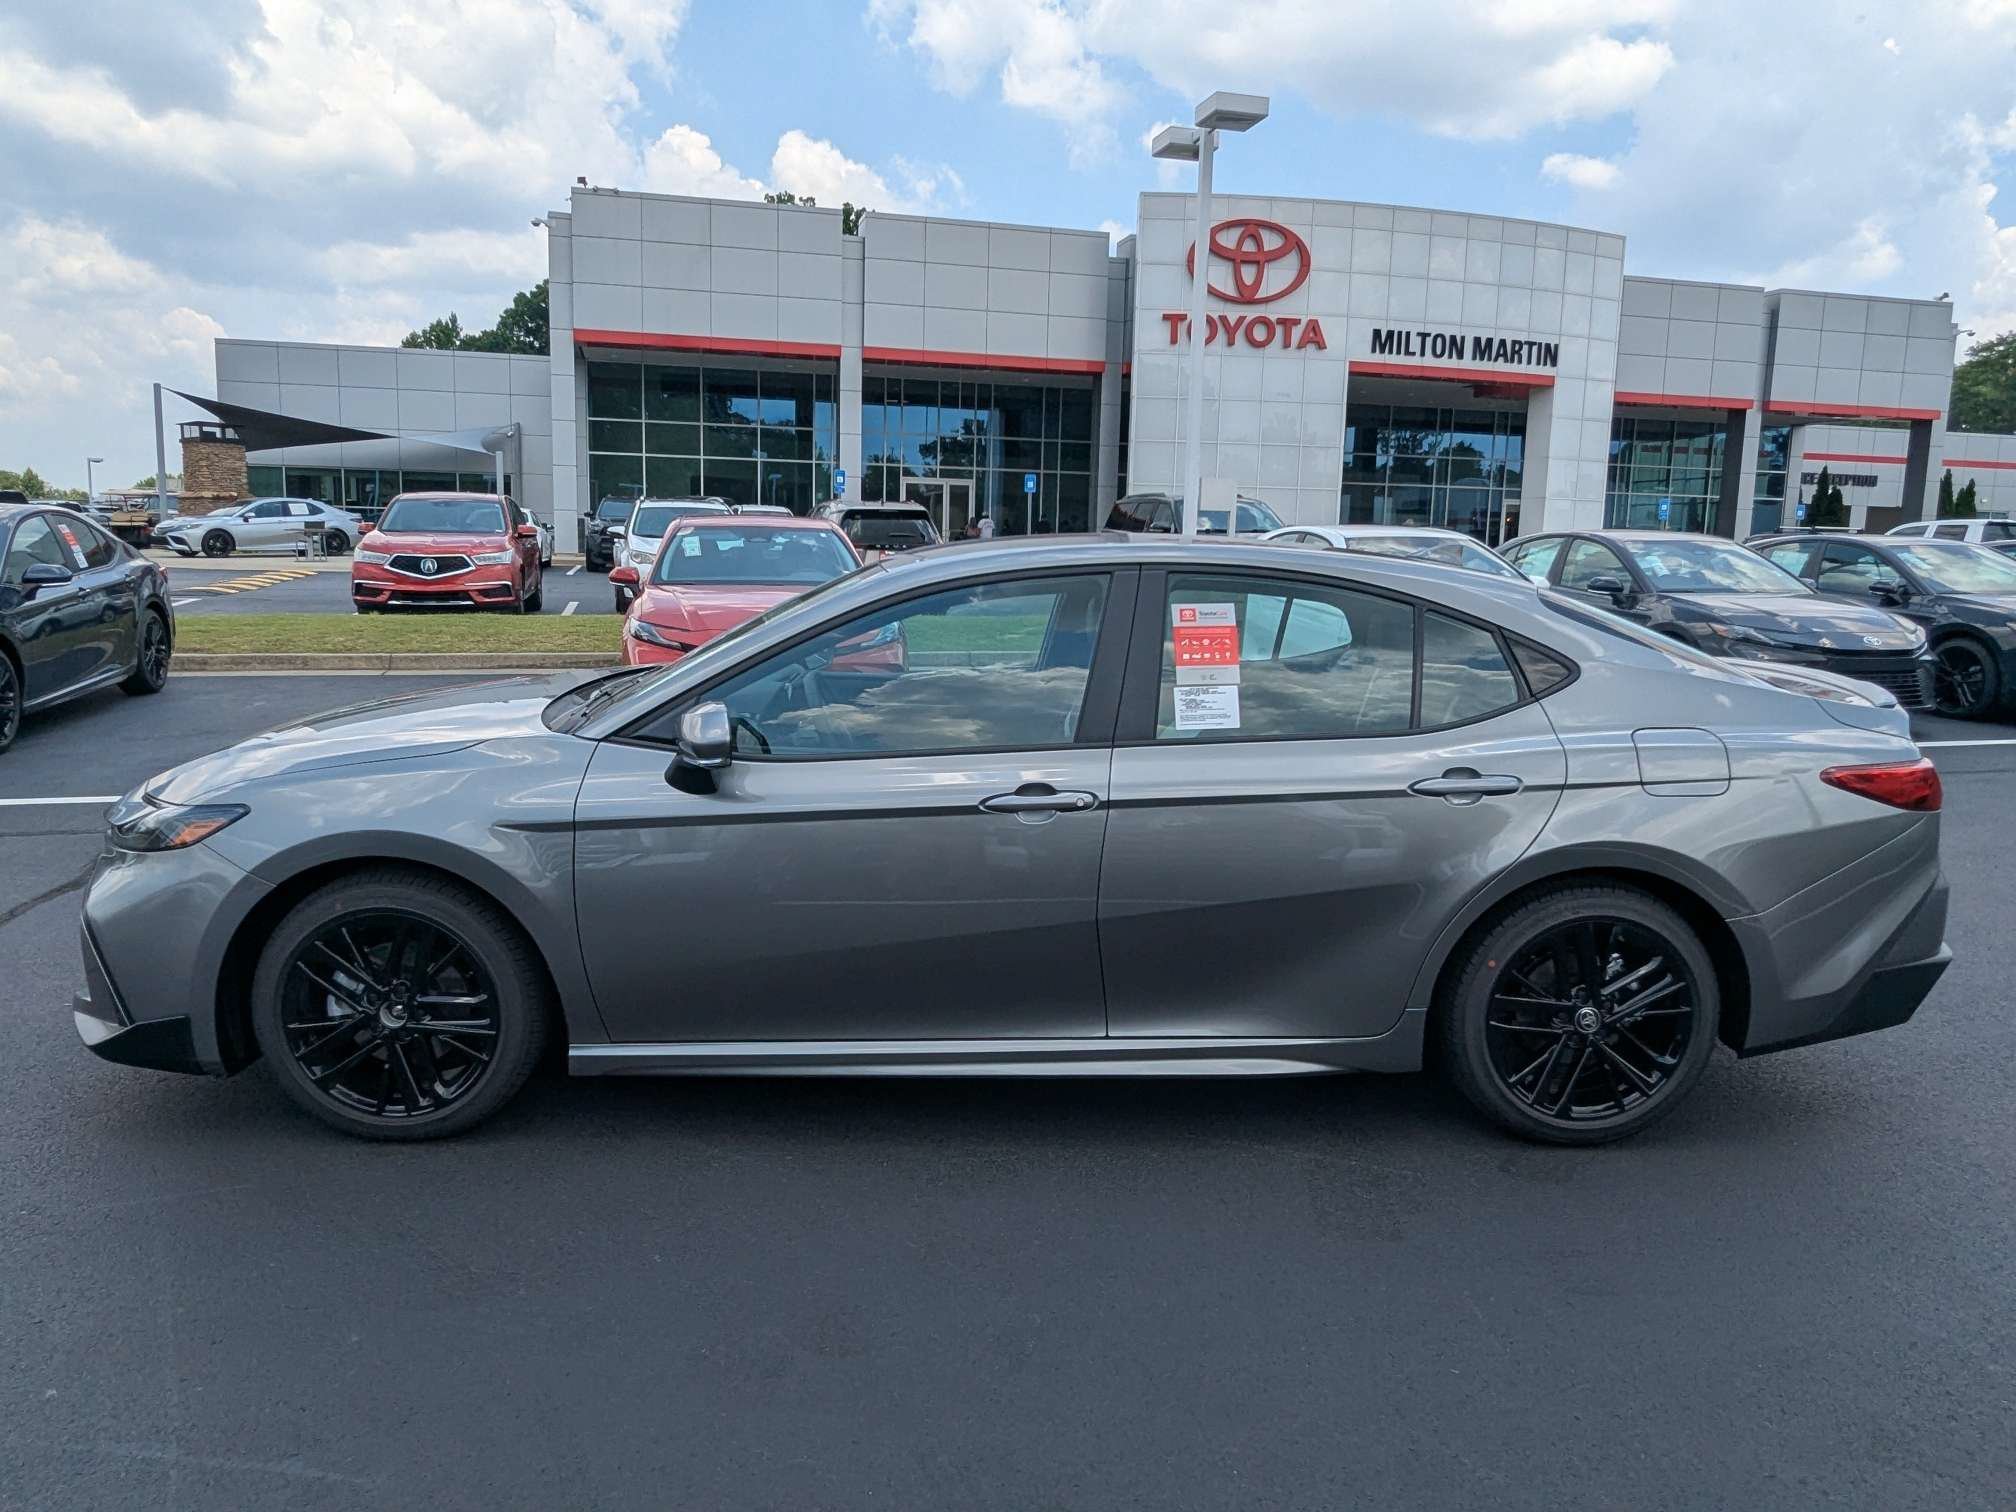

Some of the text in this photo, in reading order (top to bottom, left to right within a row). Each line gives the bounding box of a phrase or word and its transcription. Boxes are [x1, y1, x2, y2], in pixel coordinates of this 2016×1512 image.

[1162, 313, 1327, 349] TOYOTA
[1370, 328, 1559, 367] MILTON MARTIN
